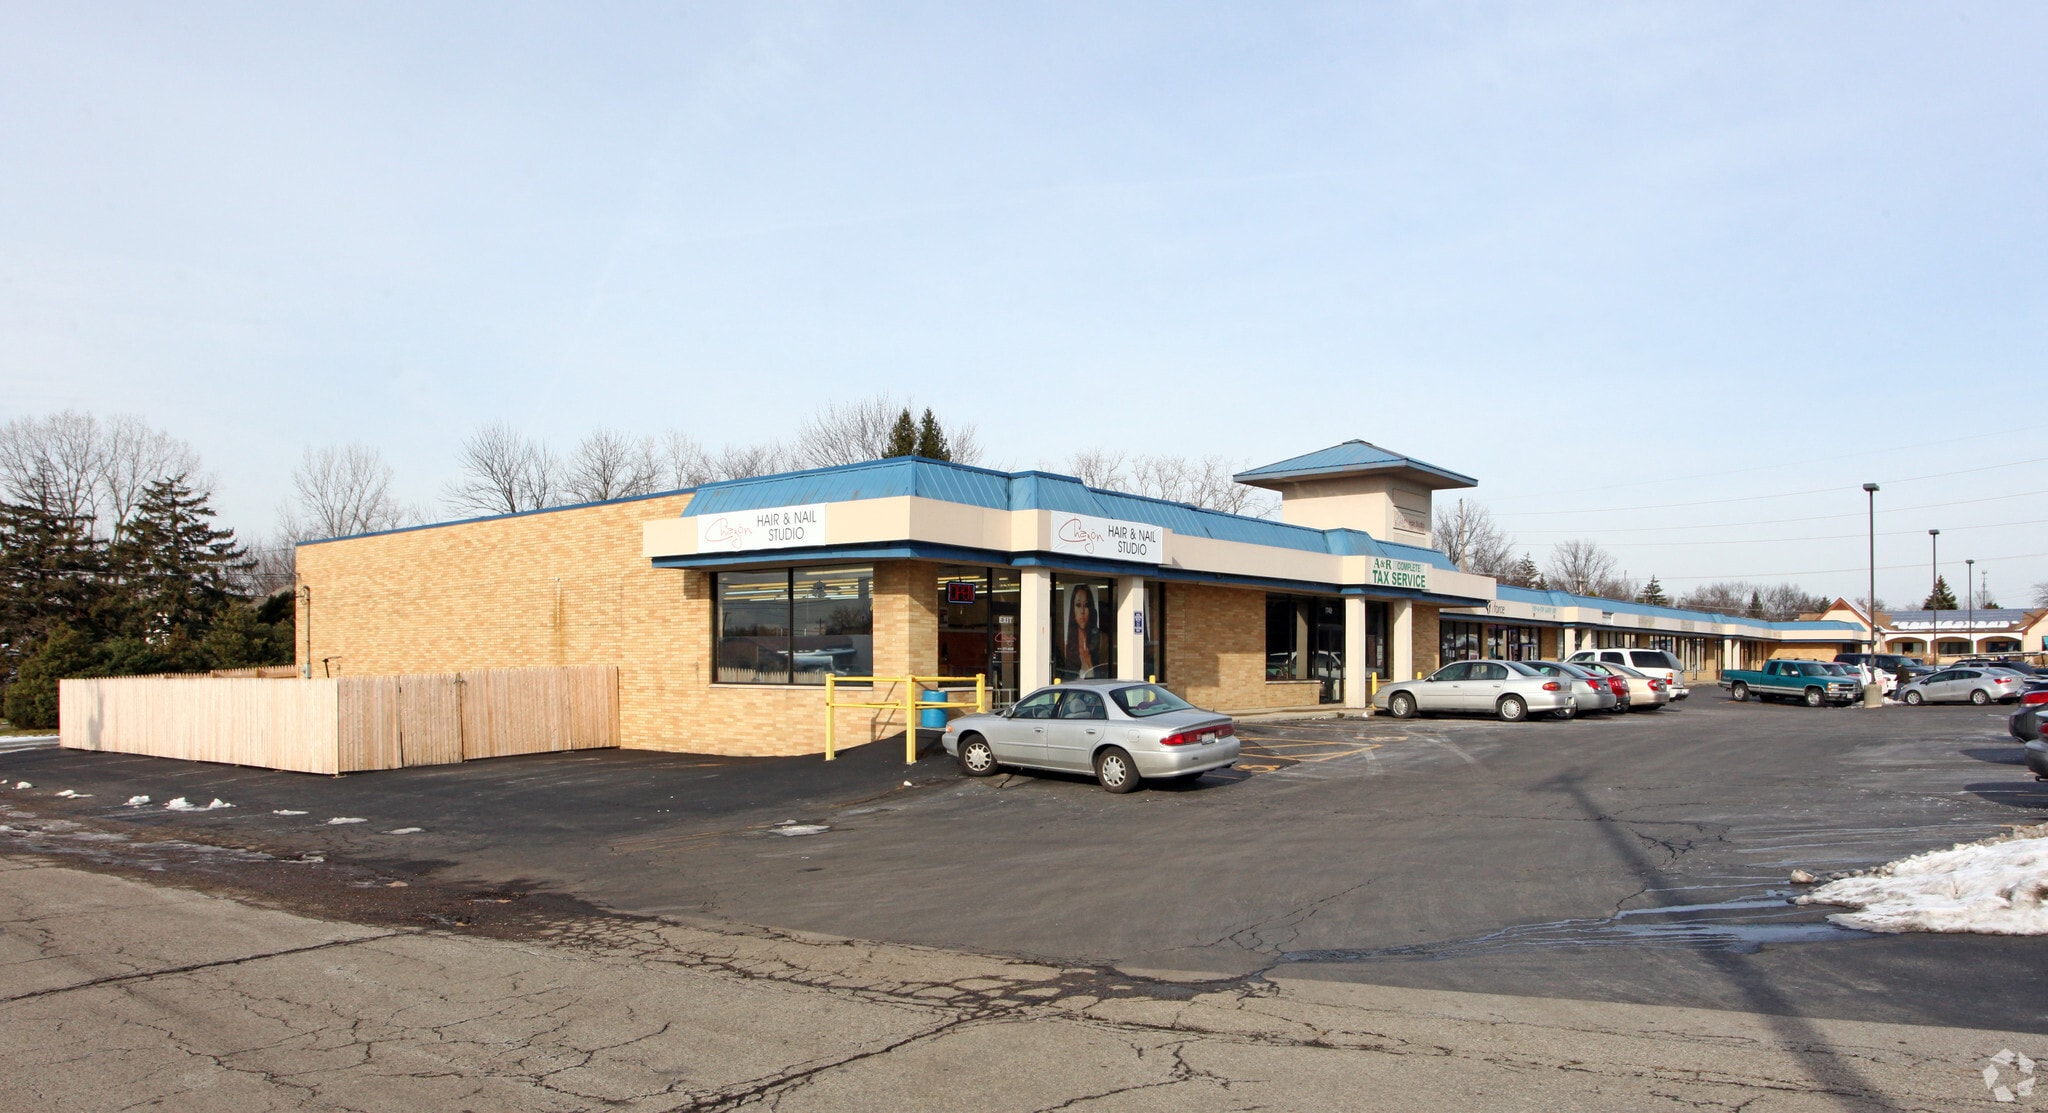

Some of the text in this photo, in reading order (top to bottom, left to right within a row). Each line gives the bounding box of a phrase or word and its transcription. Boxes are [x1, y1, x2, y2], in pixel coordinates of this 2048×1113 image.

[757, 510, 816, 527] HAIR & NAIL
[768, 527, 805, 541] STUDIO
[1108, 525, 1156, 543] HAIR & NAIL
[1118, 541, 1147, 556] STUDIO
[1373, 558, 1421, 573] A&R COMPLETE
[1372, 570, 1426, 588] TAX SERVICE
[951, 585, 975, 601] OPEN
[999, 615, 1013, 624] EXIT
